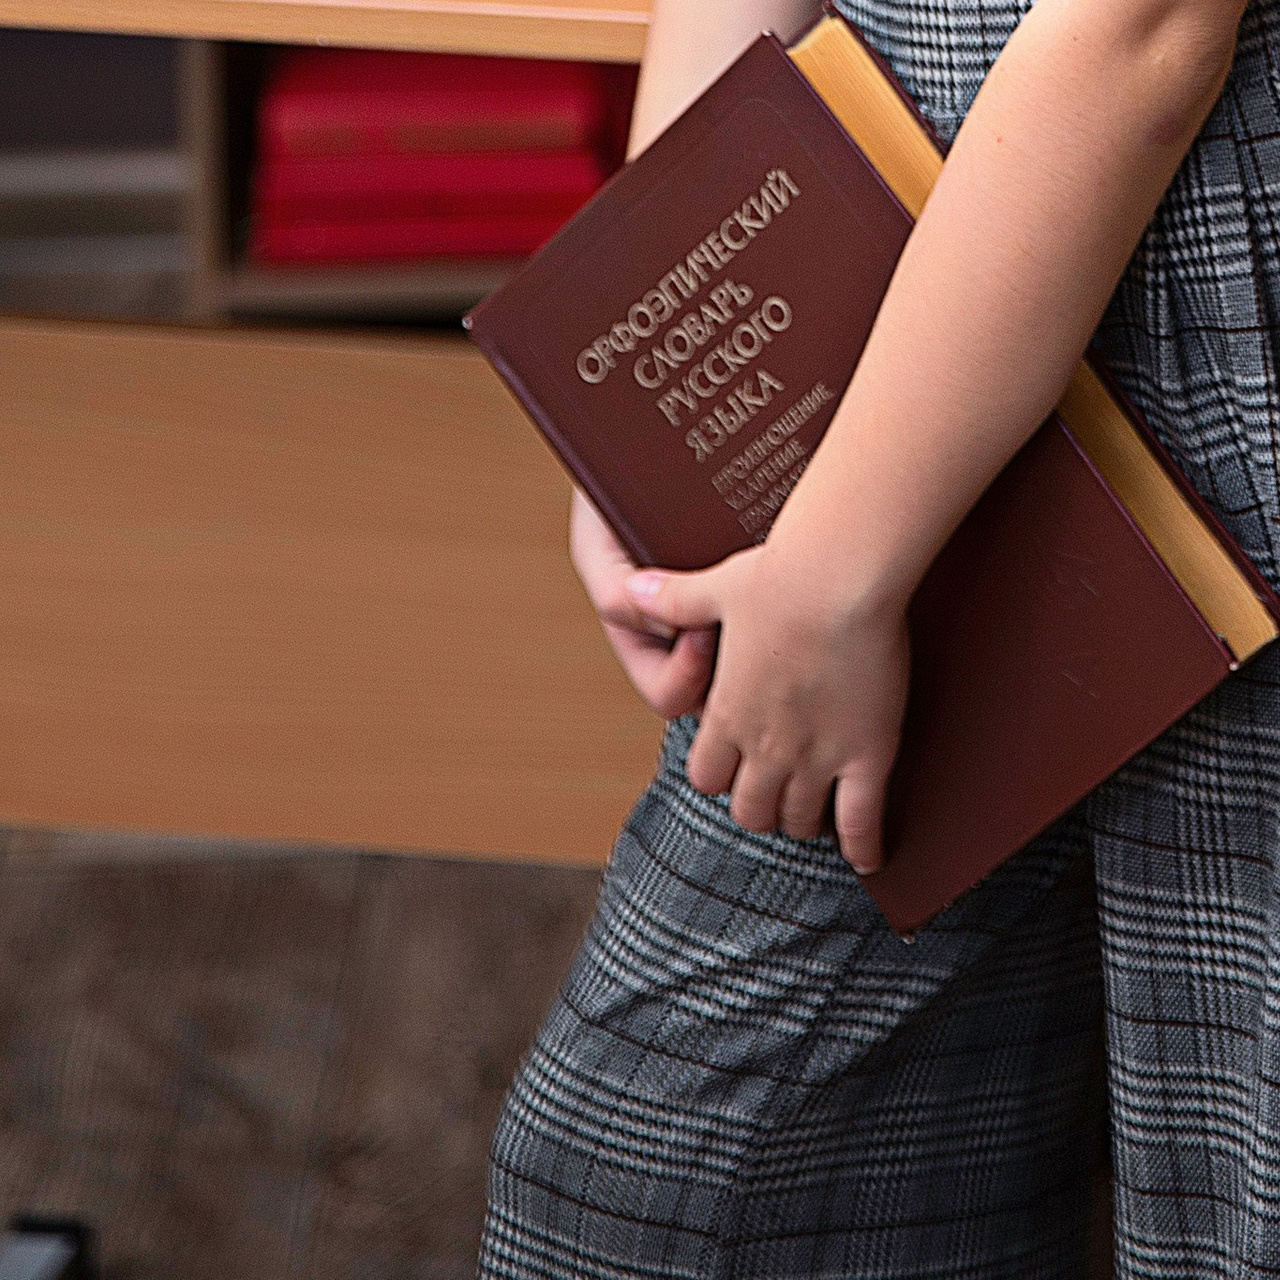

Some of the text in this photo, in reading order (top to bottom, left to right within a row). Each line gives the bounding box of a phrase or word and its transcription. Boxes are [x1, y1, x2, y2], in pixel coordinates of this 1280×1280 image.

[576, 169, 800, 384] ОРФОЭПИЧЕСКИЙ
[633, 279, 754, 389] СЛОВАРЬ
[656, 296, 793, 427] РУССКОГО
[685, 368, 785, 463] ЯЗЫКА
